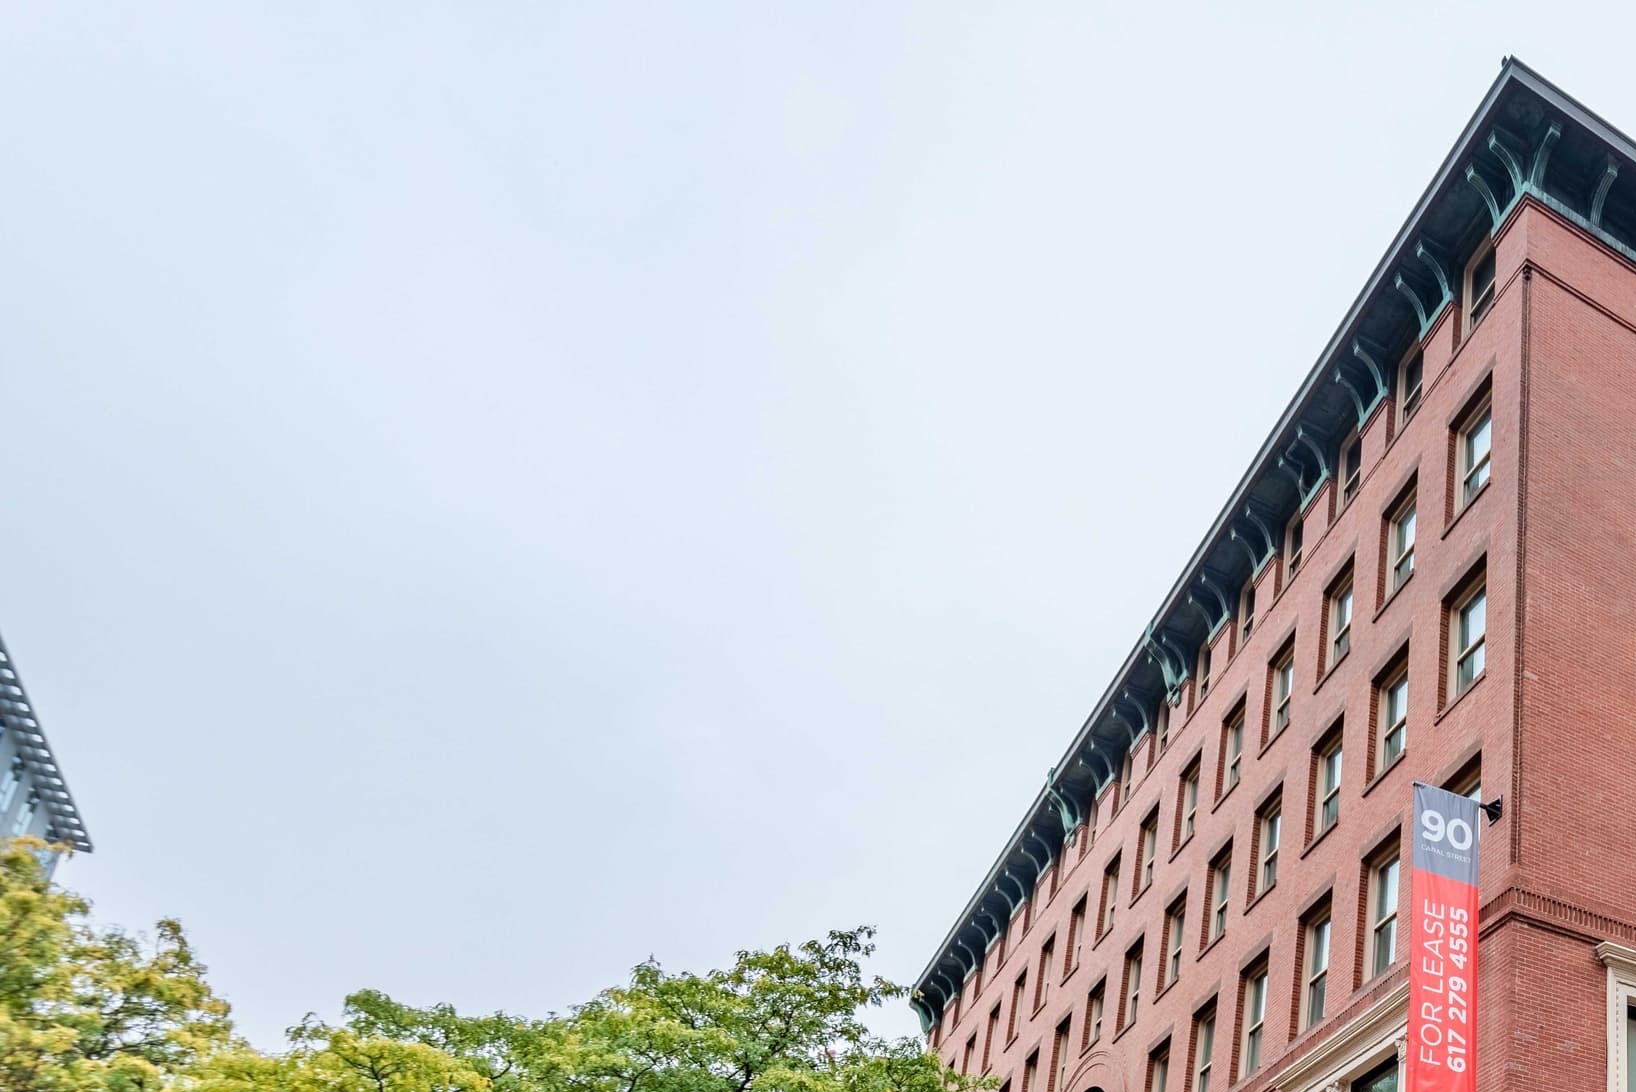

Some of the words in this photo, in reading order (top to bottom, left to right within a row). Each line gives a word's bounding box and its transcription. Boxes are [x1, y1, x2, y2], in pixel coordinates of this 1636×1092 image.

[1421, 809, 1473, 851] 90
[1421, 843, 1445, 857] CANAL
[1446, 851, 1471, 864] STREET
[1422, 898, 1445, 994] LEASE
[1449, 906, 1469, 970] 4555
[1448, 976, 1467, 1024] 279
[1419, 1001, 1443, 1066] FOR
[1447, 1028, 1467, 1073] 617
